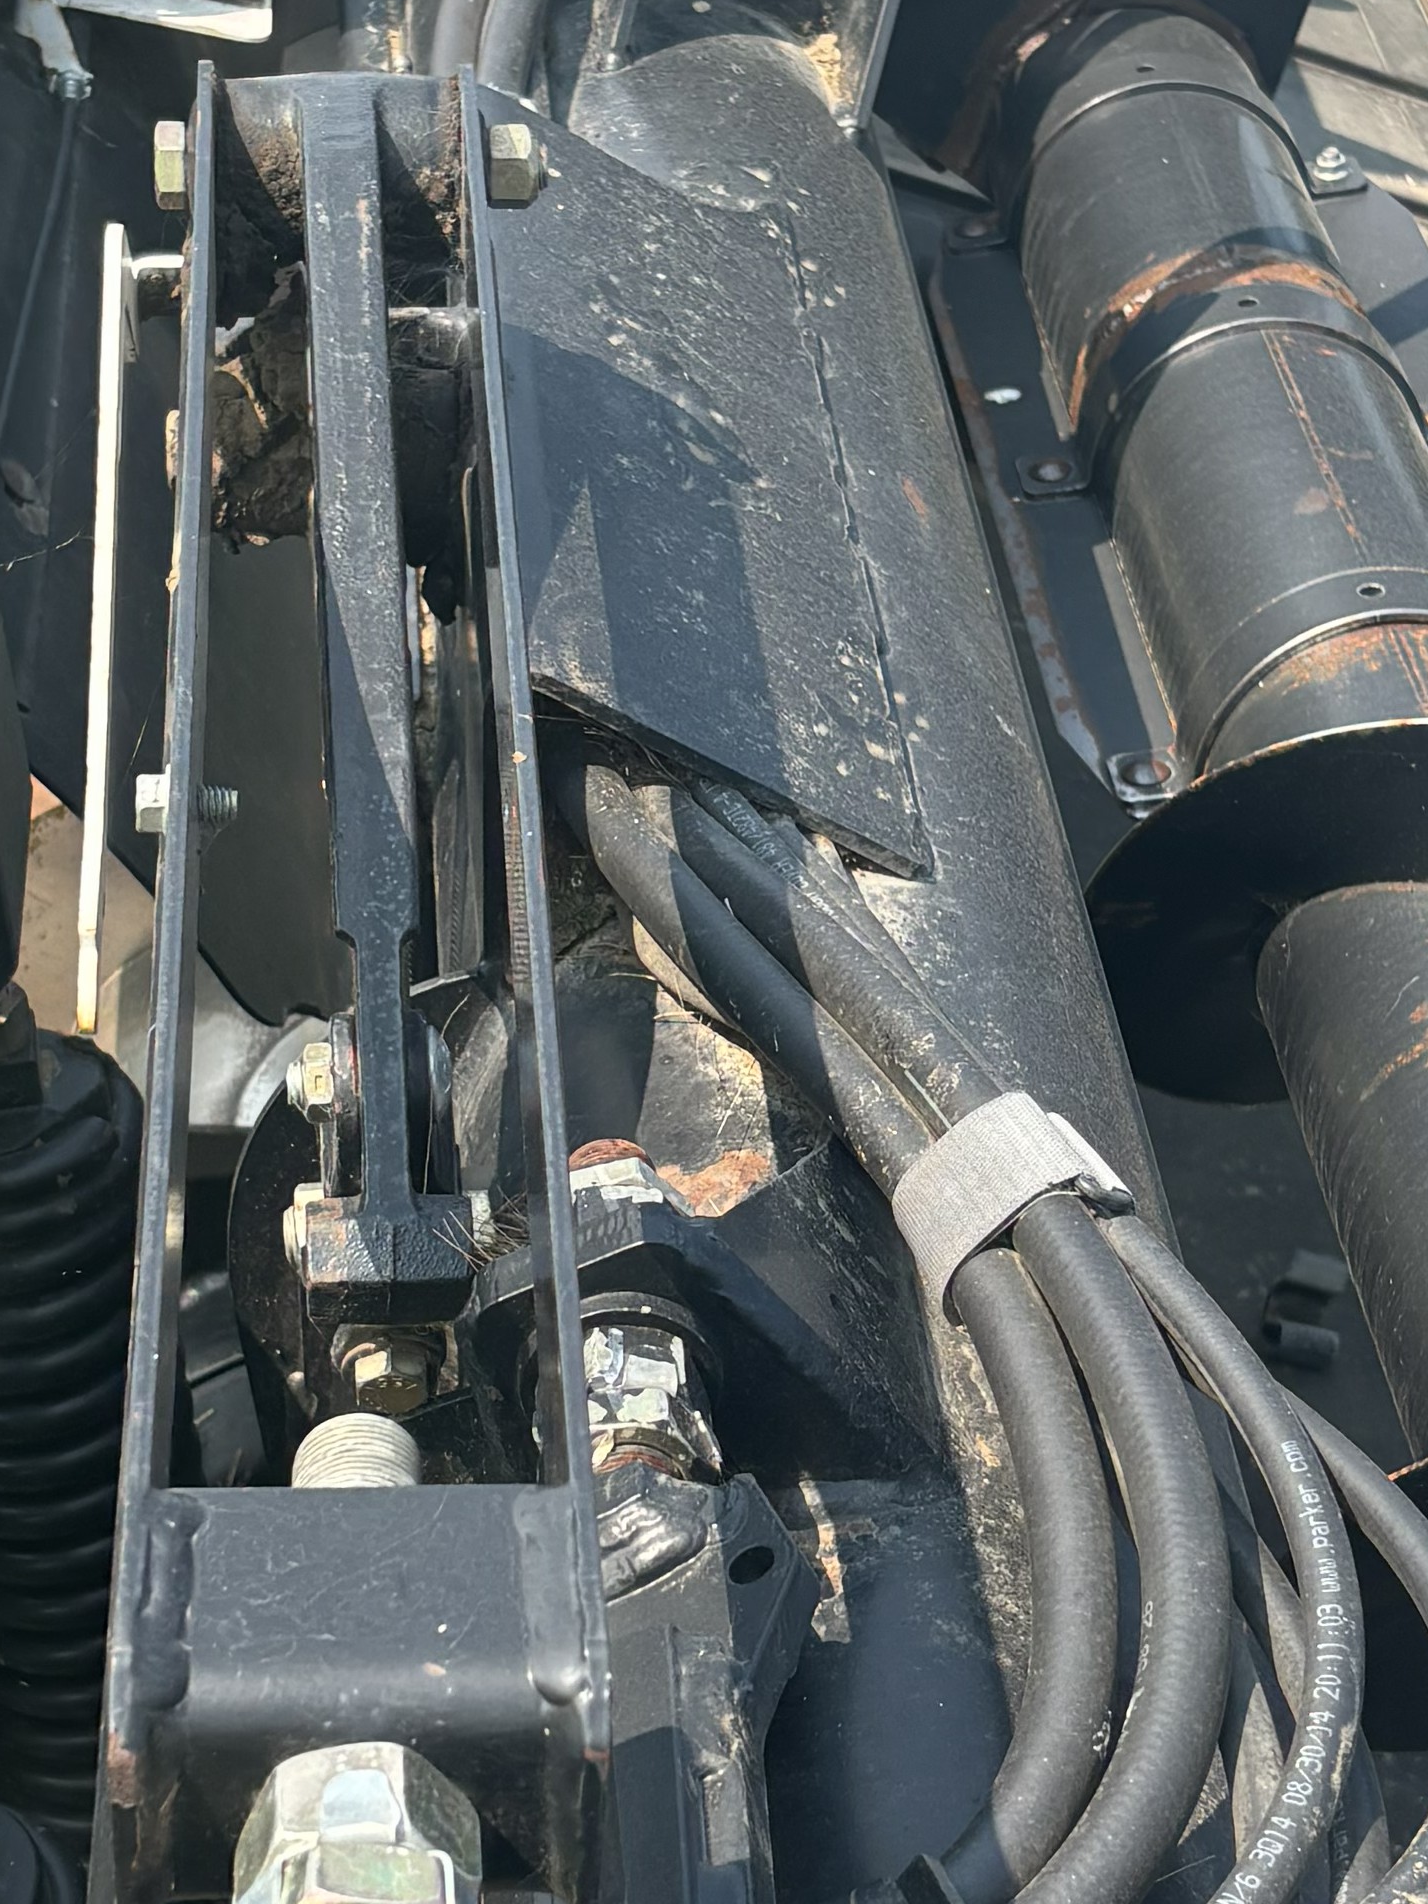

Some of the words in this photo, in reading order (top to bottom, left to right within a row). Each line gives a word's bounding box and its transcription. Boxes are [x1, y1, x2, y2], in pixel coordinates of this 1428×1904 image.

[1280, 1439, 1342, 1594] www.parker.com
[1312, 1602, 1350, 1702] 20:11:03
[1281, 1709, 1336, 1807] 08/30/14
